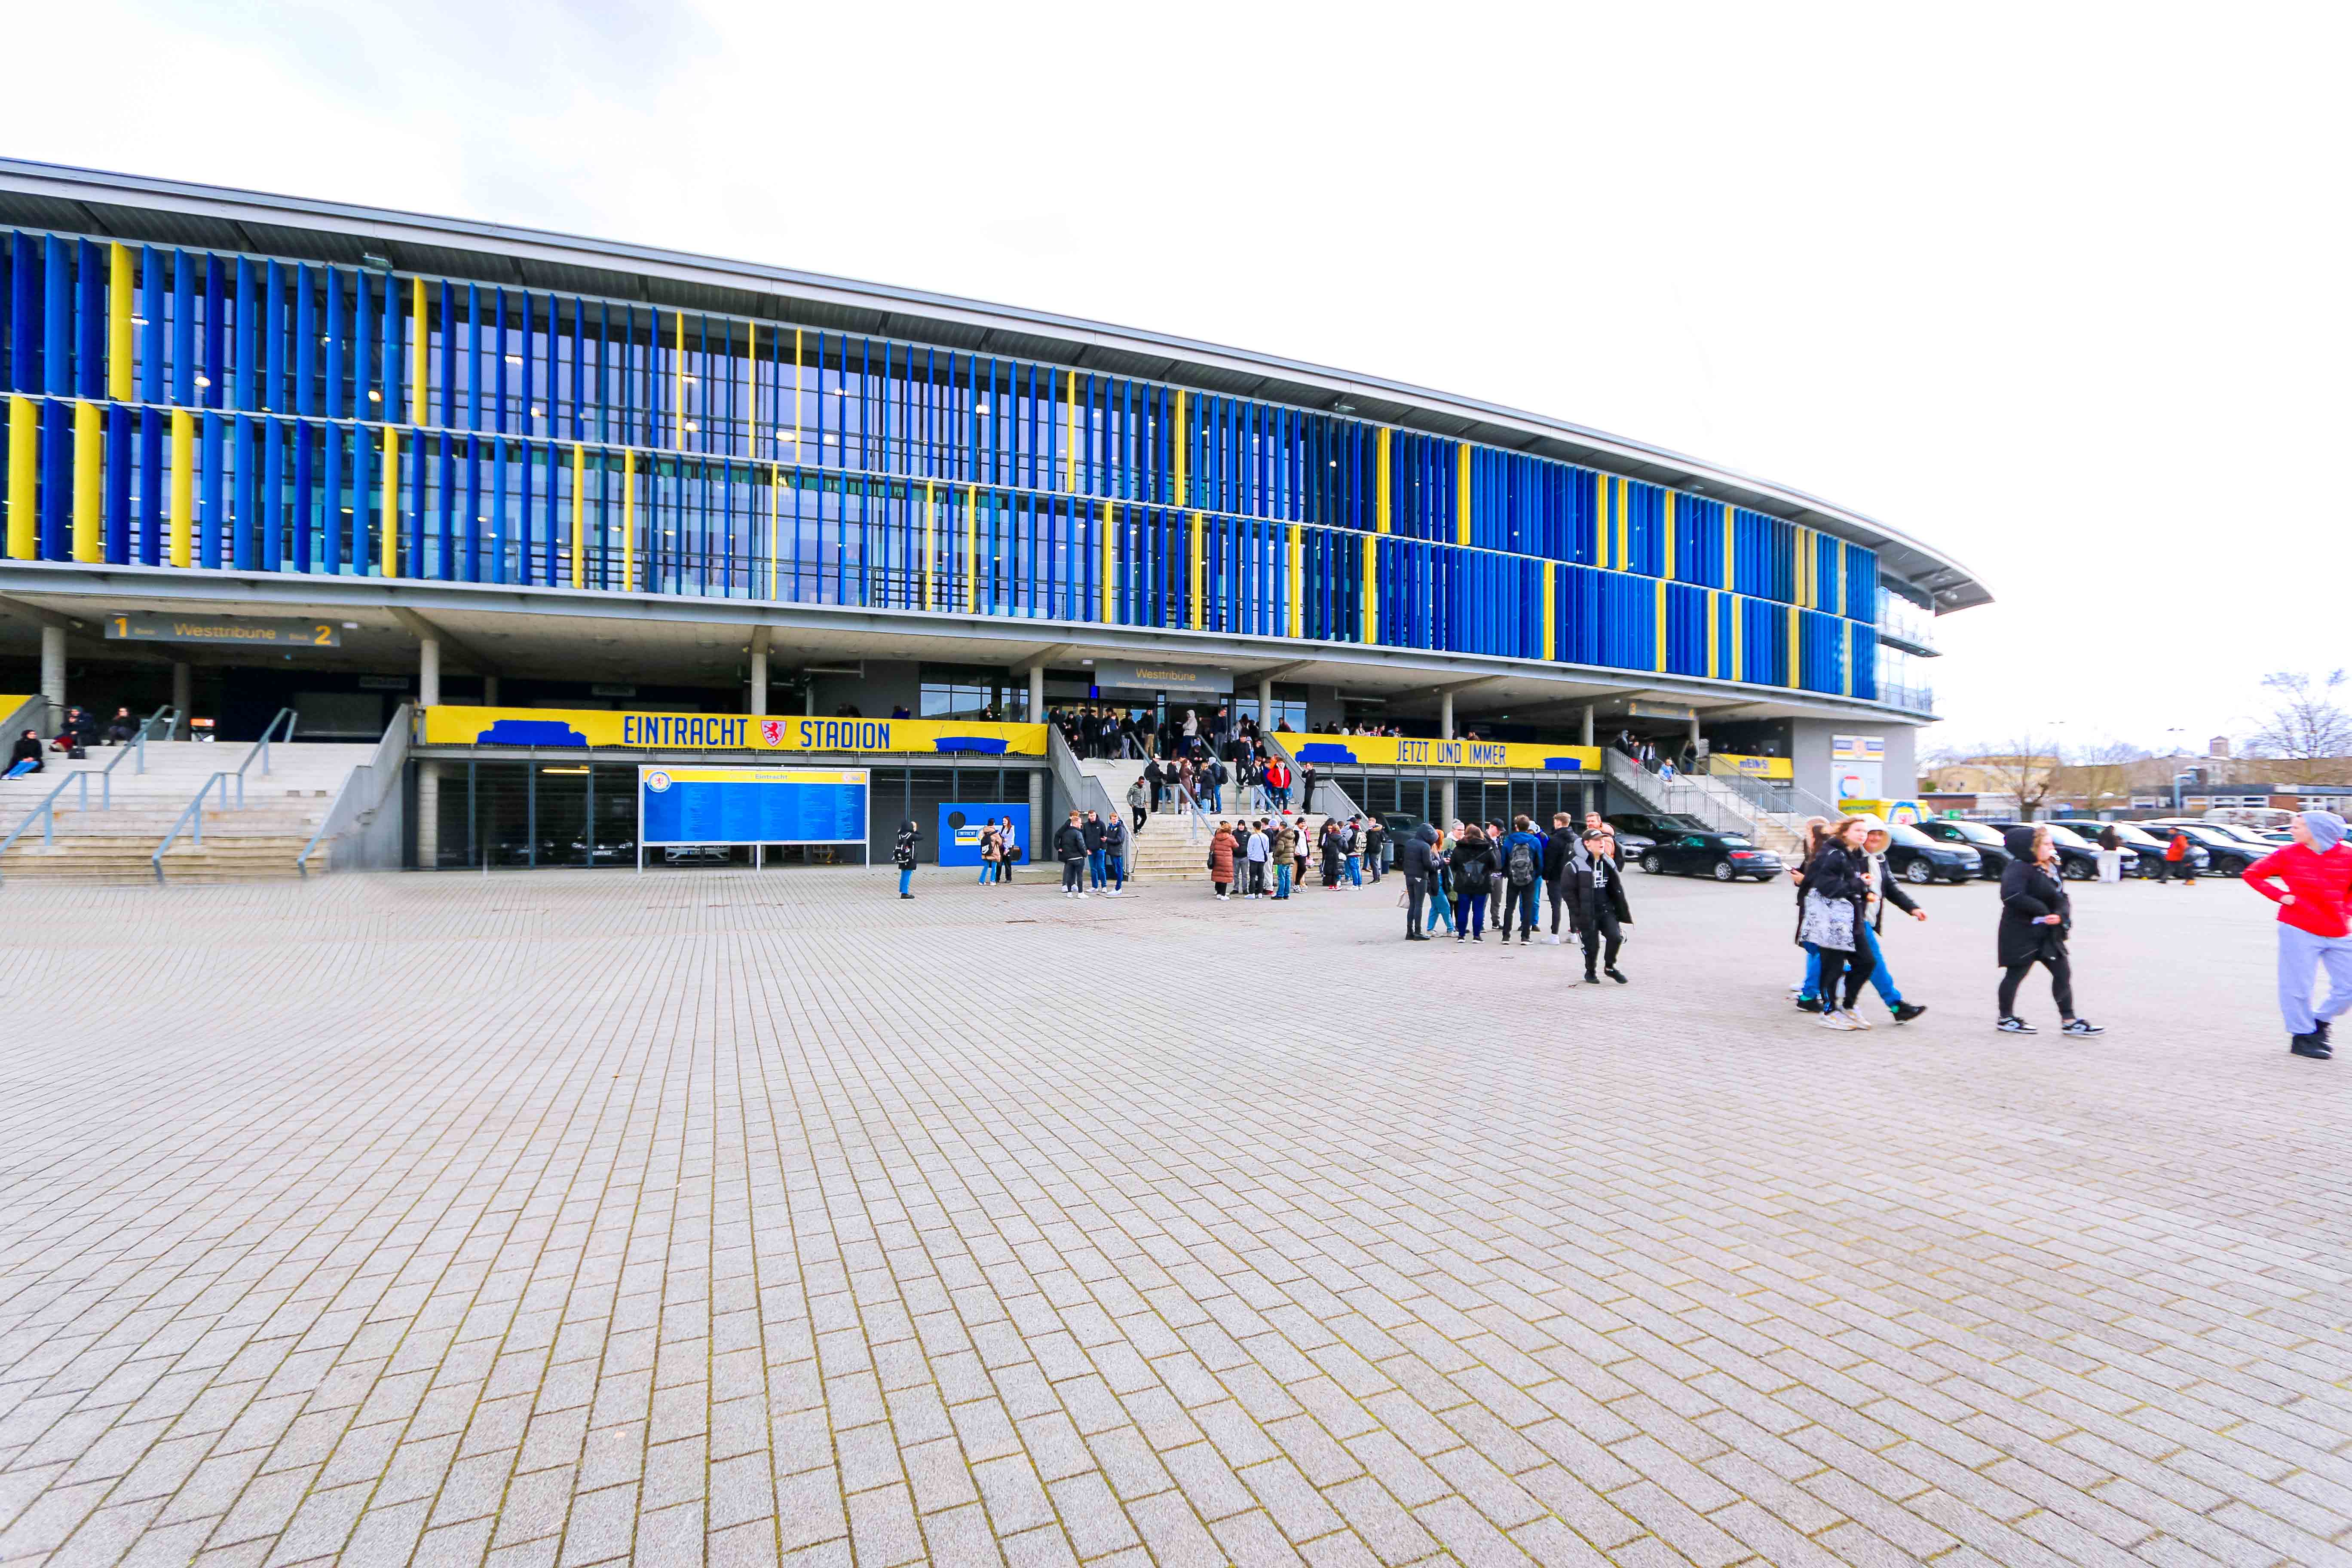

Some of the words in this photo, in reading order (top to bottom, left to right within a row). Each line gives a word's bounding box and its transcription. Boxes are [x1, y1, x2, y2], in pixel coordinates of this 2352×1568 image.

[114, 618, 127, 638] 1
[174, 622, 276, 640] Westtribüne
[314, 625, 331, 645] 2
[1136, 668, 1196, 682] Westtribüne
[624, 716, 748, 746] EINTRACHT
[800, 721, 890, 749] STADION
[1396, 741, 1430, 762] JETZT
[1437, 742, 1461, 763] UND
[1469, 743, 1507, 765] IMMER
